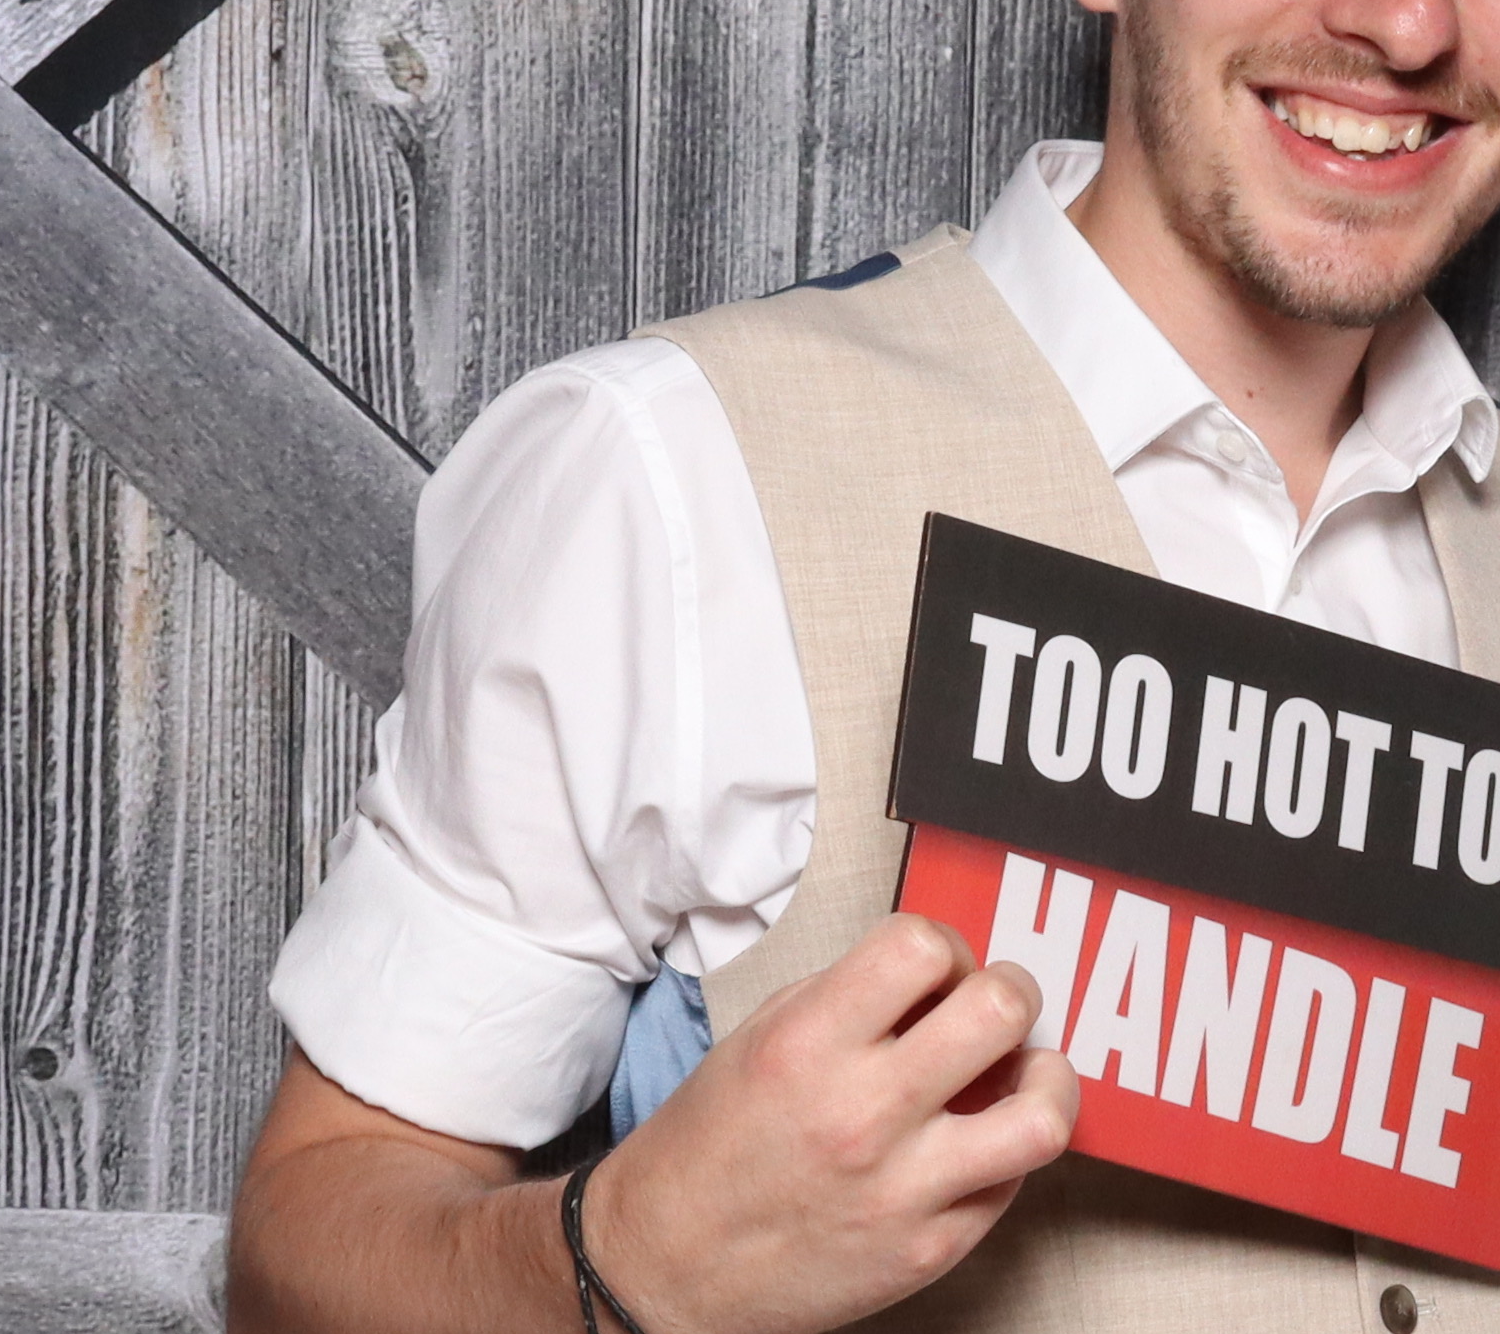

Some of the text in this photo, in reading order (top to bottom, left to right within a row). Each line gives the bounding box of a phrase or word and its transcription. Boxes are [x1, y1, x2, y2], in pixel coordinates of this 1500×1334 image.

[970, 612, 1174, 800] TOO
[1191, 675, 1393, 853] HOT
[985, 851, 1485, 1189] HANDLE
